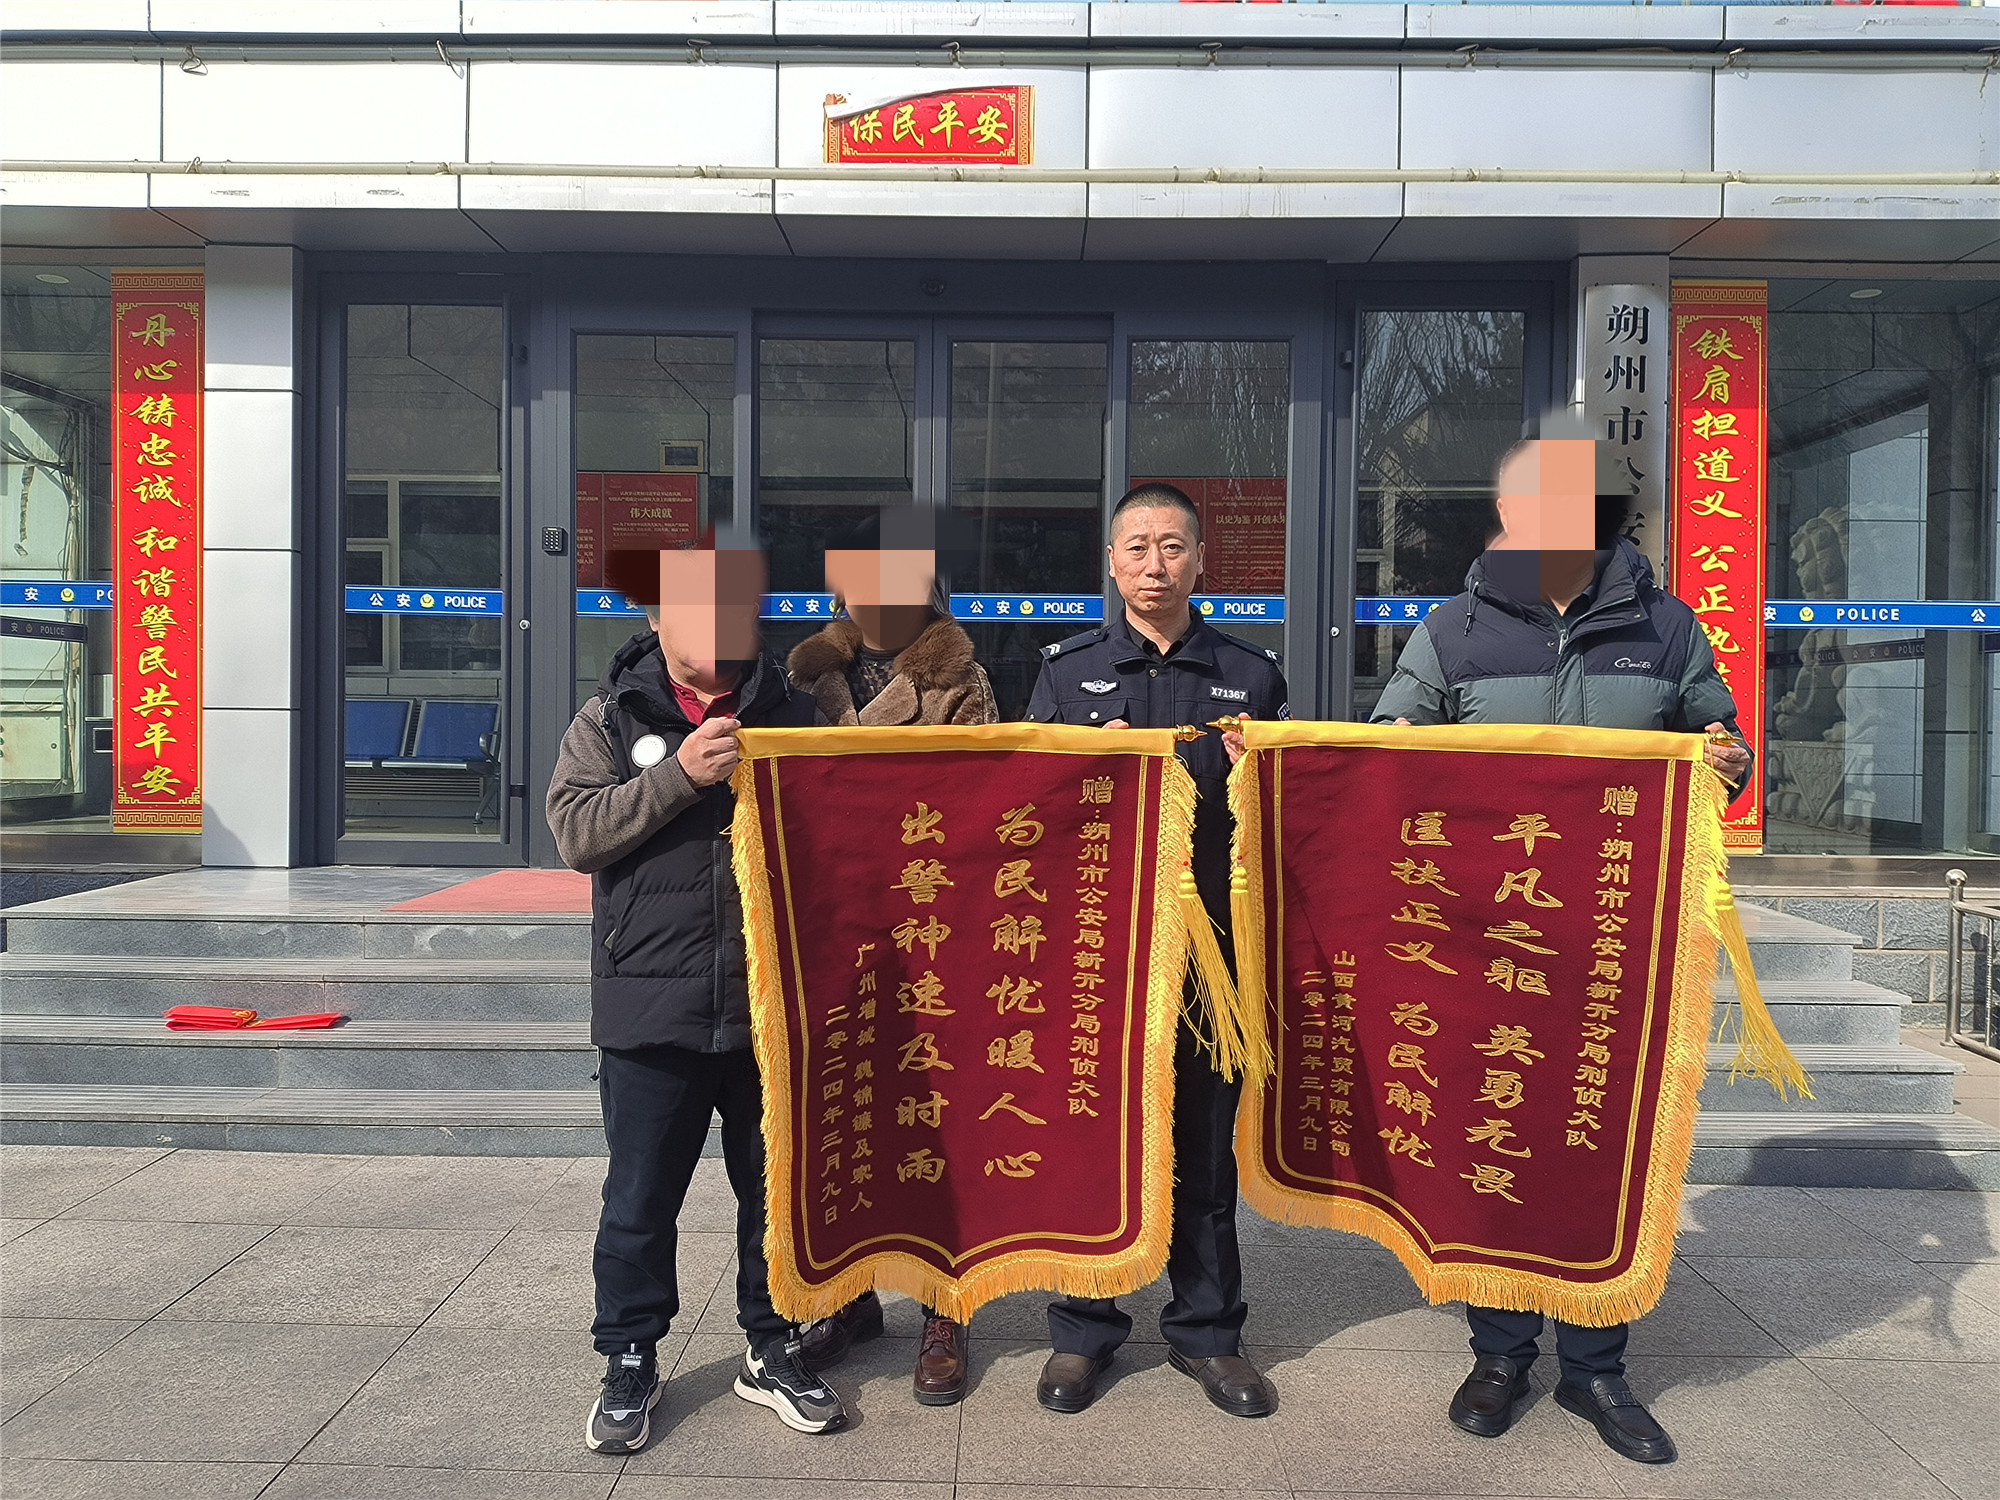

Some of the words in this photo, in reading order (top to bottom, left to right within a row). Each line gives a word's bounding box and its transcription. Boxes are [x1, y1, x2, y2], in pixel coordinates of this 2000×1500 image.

[849, 101, 1008, 149] 保民平安
[131, 312, 182, 508] 丹心铸忠诚
[1689, 327, 1744, 518] 铁肩担道义
[24, 587, 39, 601] 安
[40, 625, 65, 636] POLICE
[370, 592, 411, 608] 公安
[444, 595, 487, 609] POLICE
[779, 599, 820, 613] 公安
[969, 599, 1011, 615] 公安
[1043, 602, 1085, 614] POLICE
[1224, 602, 1266, 615] POLICE
[1376, 602, 1419, 618] 公安
[1836, 607, 1900, 621] POLICE
[1971, 608, 1987, 623] 公
[131, 525, 181, 796] 和谐警民共平安
[1211, 686, 1247, 700] X71367
[1898, 643, 1925, 655] POLICE
[1384, 811, 1461, 976] 匡扶正义
[1483, 813, 1565, 997] 平凡之躯
[890, 801, 956, 1183] 出警神速及时雨
[979, 801, 1048, 1180] 为民解忧暖人心
[1298, 970, 1327, 1151] 二零二四年三月九日
[1377, 1001, 1440, 1168] 为民解忧
[1459, 1023, 1545, 1204] 英勇无畏
[820, 1004, 850, 1225] 二零二四年三月九日
